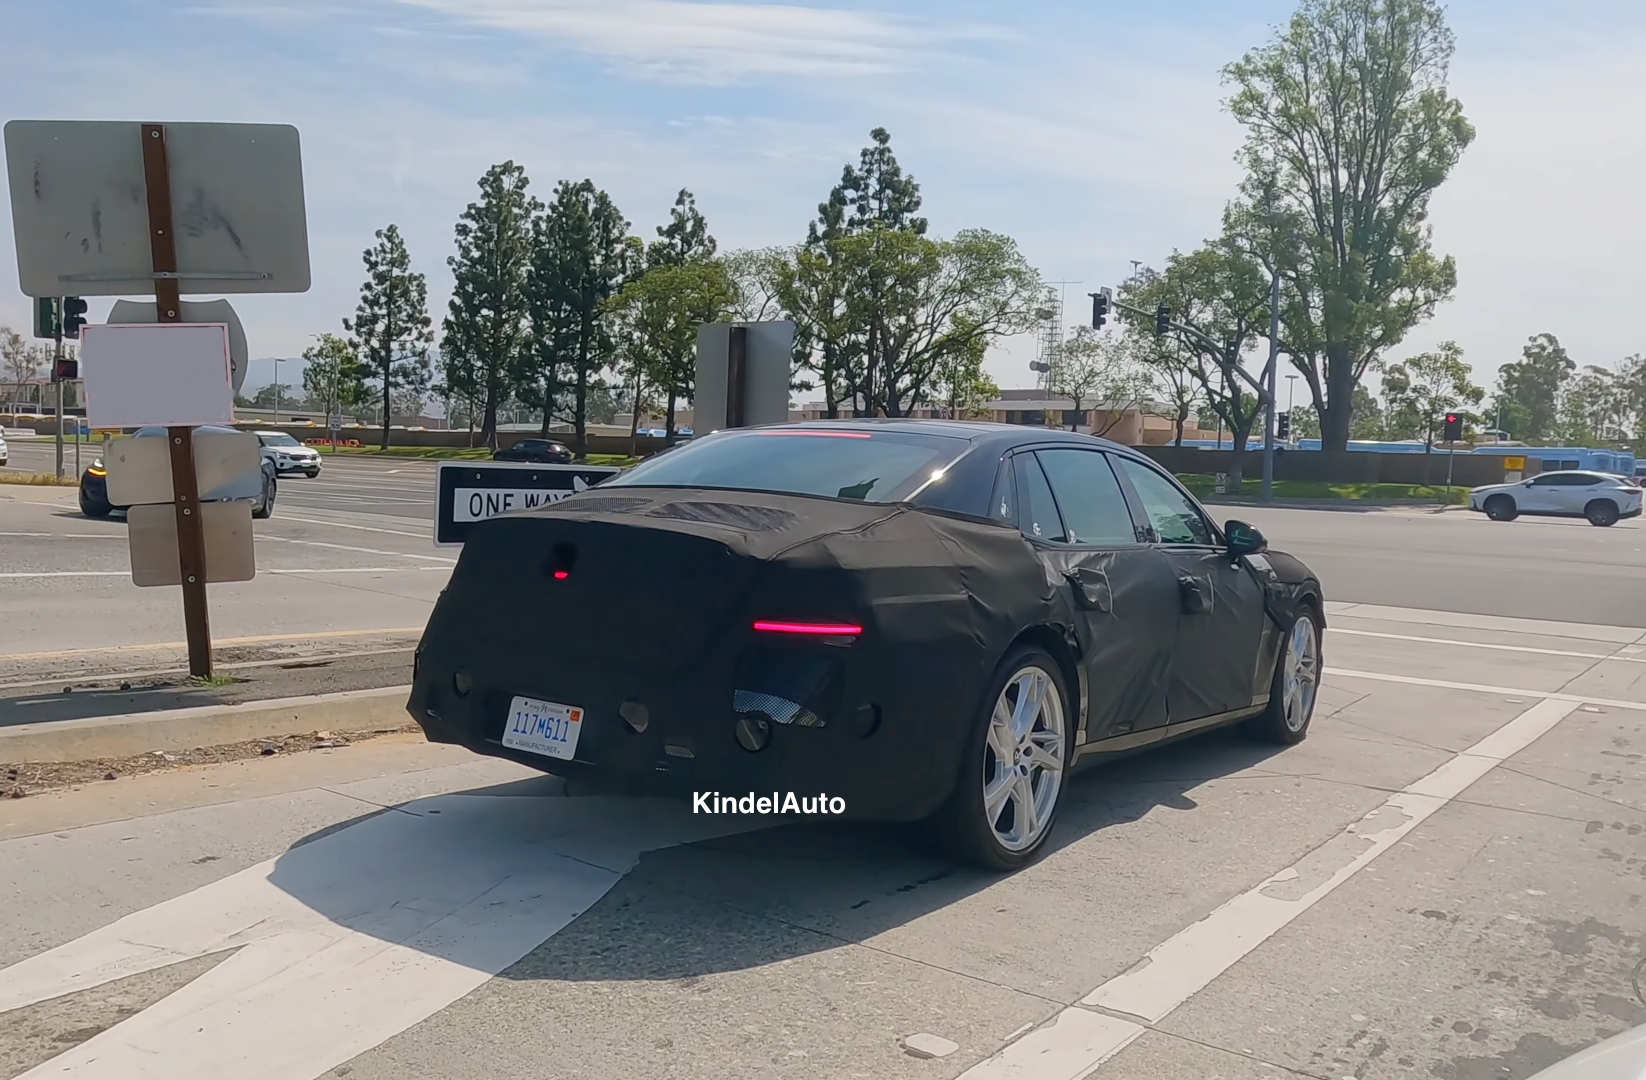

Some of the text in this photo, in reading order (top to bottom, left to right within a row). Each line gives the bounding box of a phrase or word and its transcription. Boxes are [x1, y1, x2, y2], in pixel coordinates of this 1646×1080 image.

[469, 492, 515, 517] ONE
[512, 711, 570, 743] 117M611
[518, 740, 557, 754] MANUFACTURER
